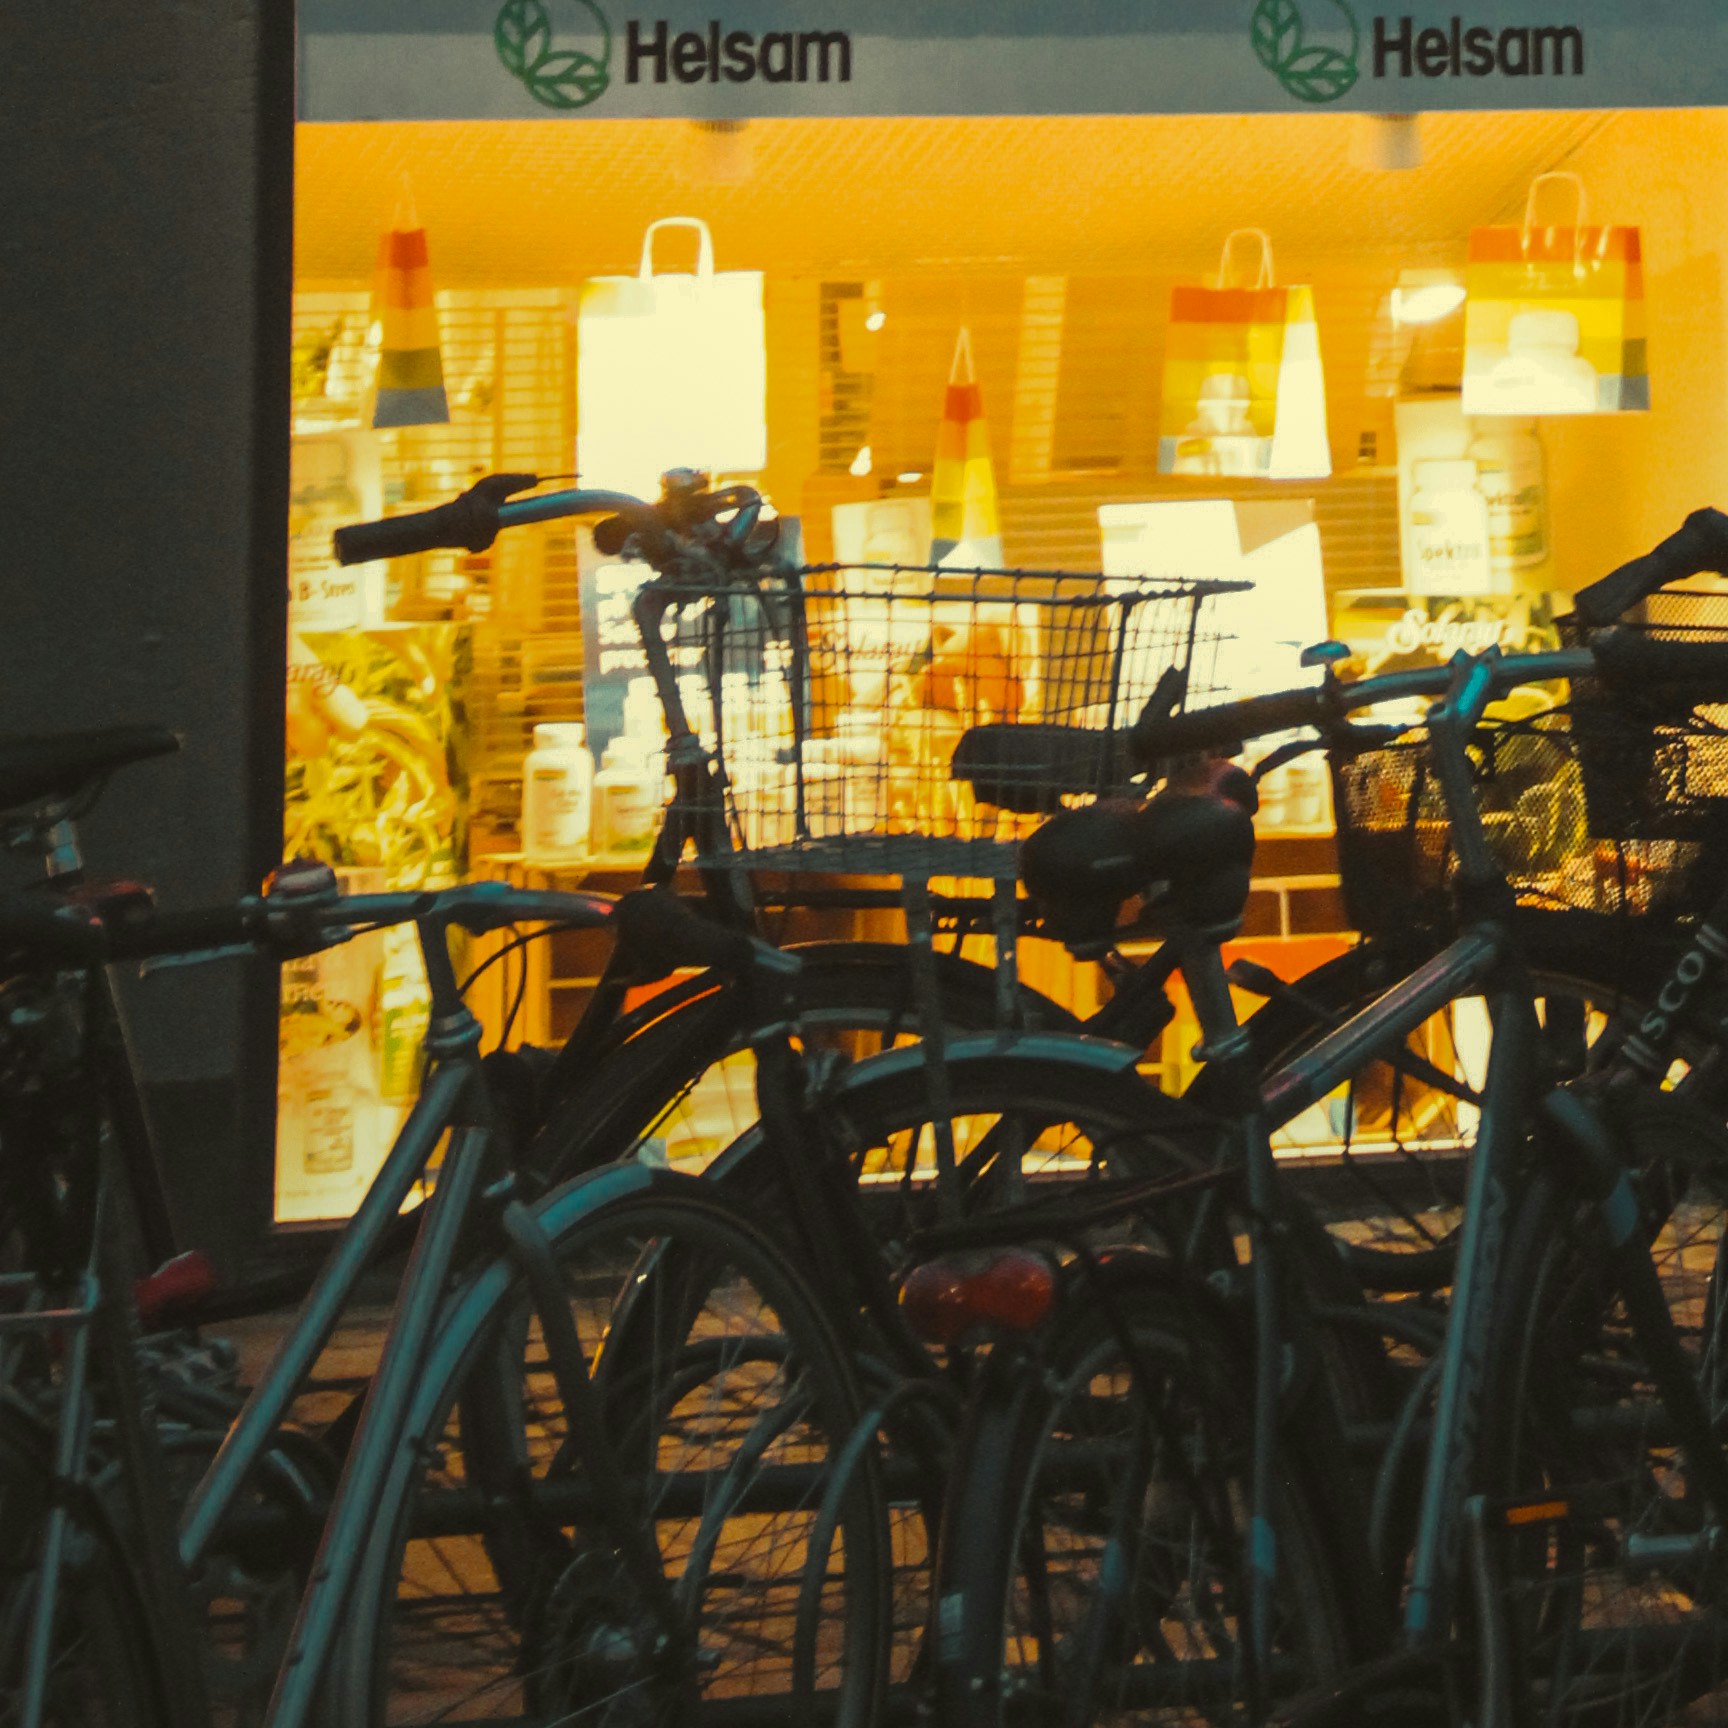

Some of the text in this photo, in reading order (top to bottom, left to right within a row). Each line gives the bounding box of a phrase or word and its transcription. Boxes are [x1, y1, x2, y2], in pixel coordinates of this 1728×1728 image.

[624, 20, 852, 86] Helsam
[1372, 16, 1585, 79] Helsam
[1639, 950, 1706, 1041] SCO
